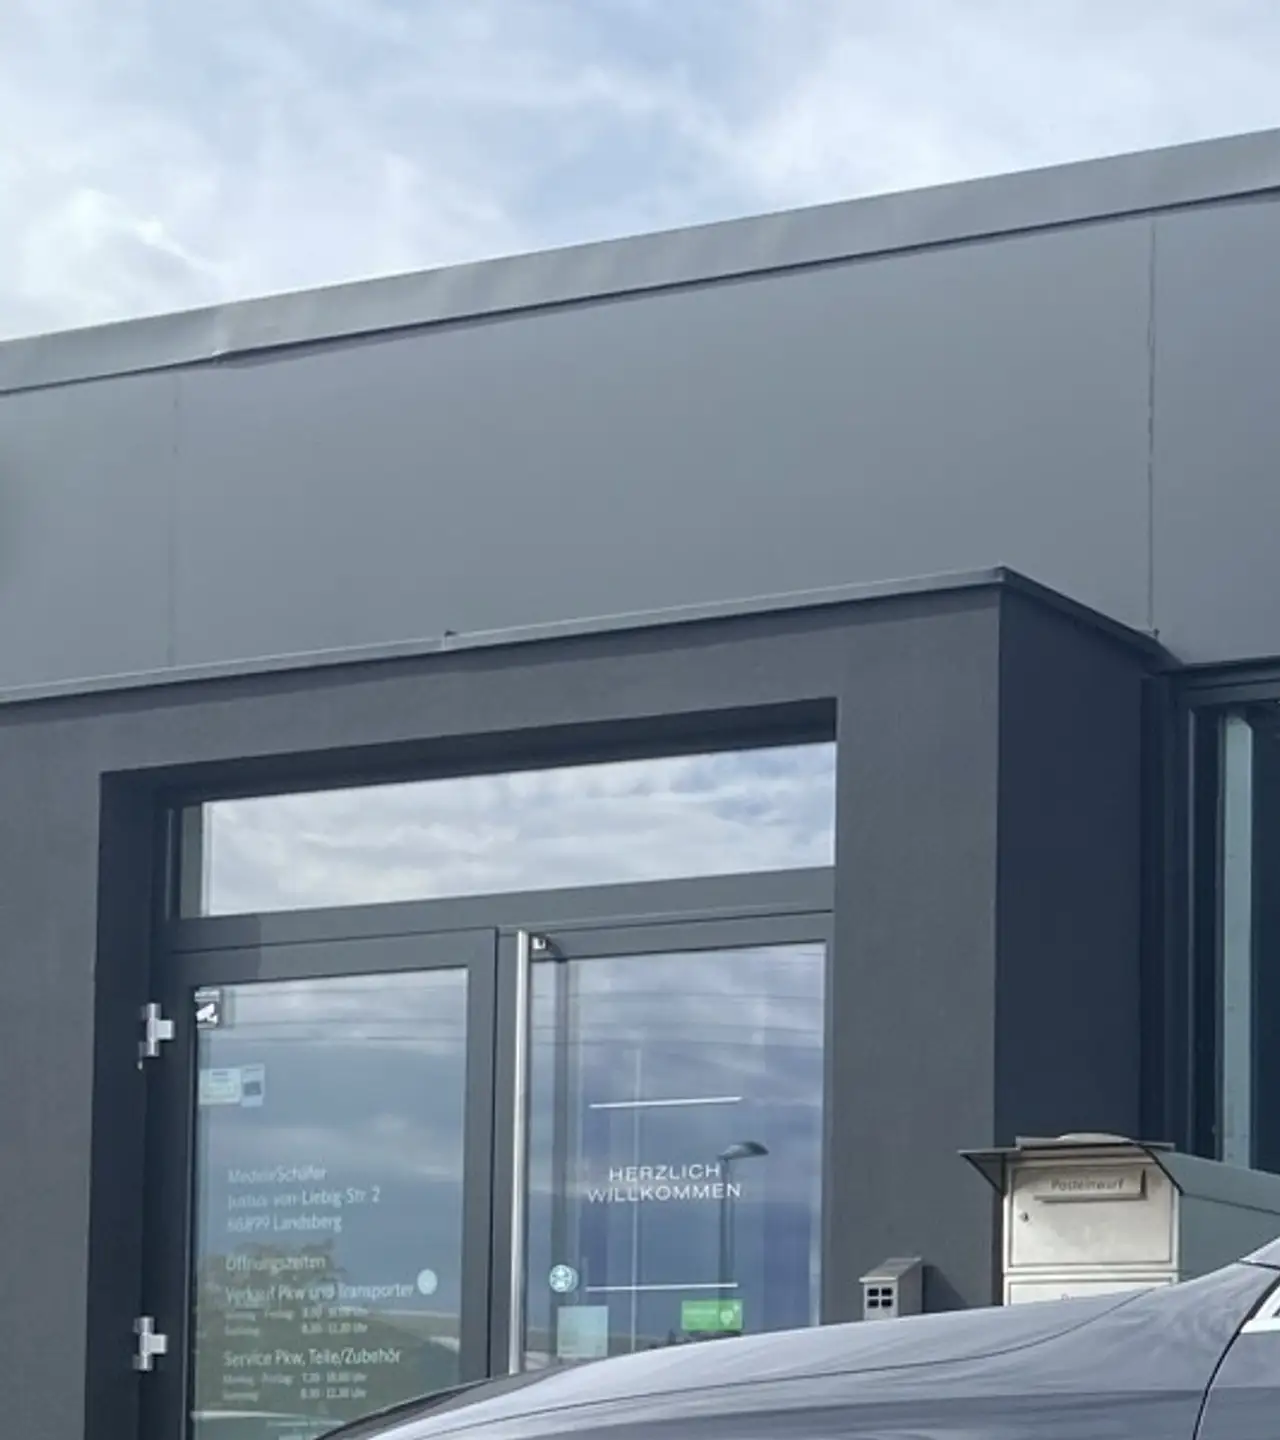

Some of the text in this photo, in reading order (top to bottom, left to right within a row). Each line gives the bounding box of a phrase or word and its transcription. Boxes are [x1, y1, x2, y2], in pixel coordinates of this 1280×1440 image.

[608, 1163, 720, 1182] HERZLICH
[587, 1182, 741, 1204] WILLKOMMEN
[1050, 1177, 1125, 1191] Posteinwurf
[273, 1213, 343, 1234] Landsberg
[278, 1284, 305, 1301] Pkw
[309, 1282, 335, 1300] und
[338, 1282, 414, 1301] Transporter
[223, 1349, 272, 1367] Service
